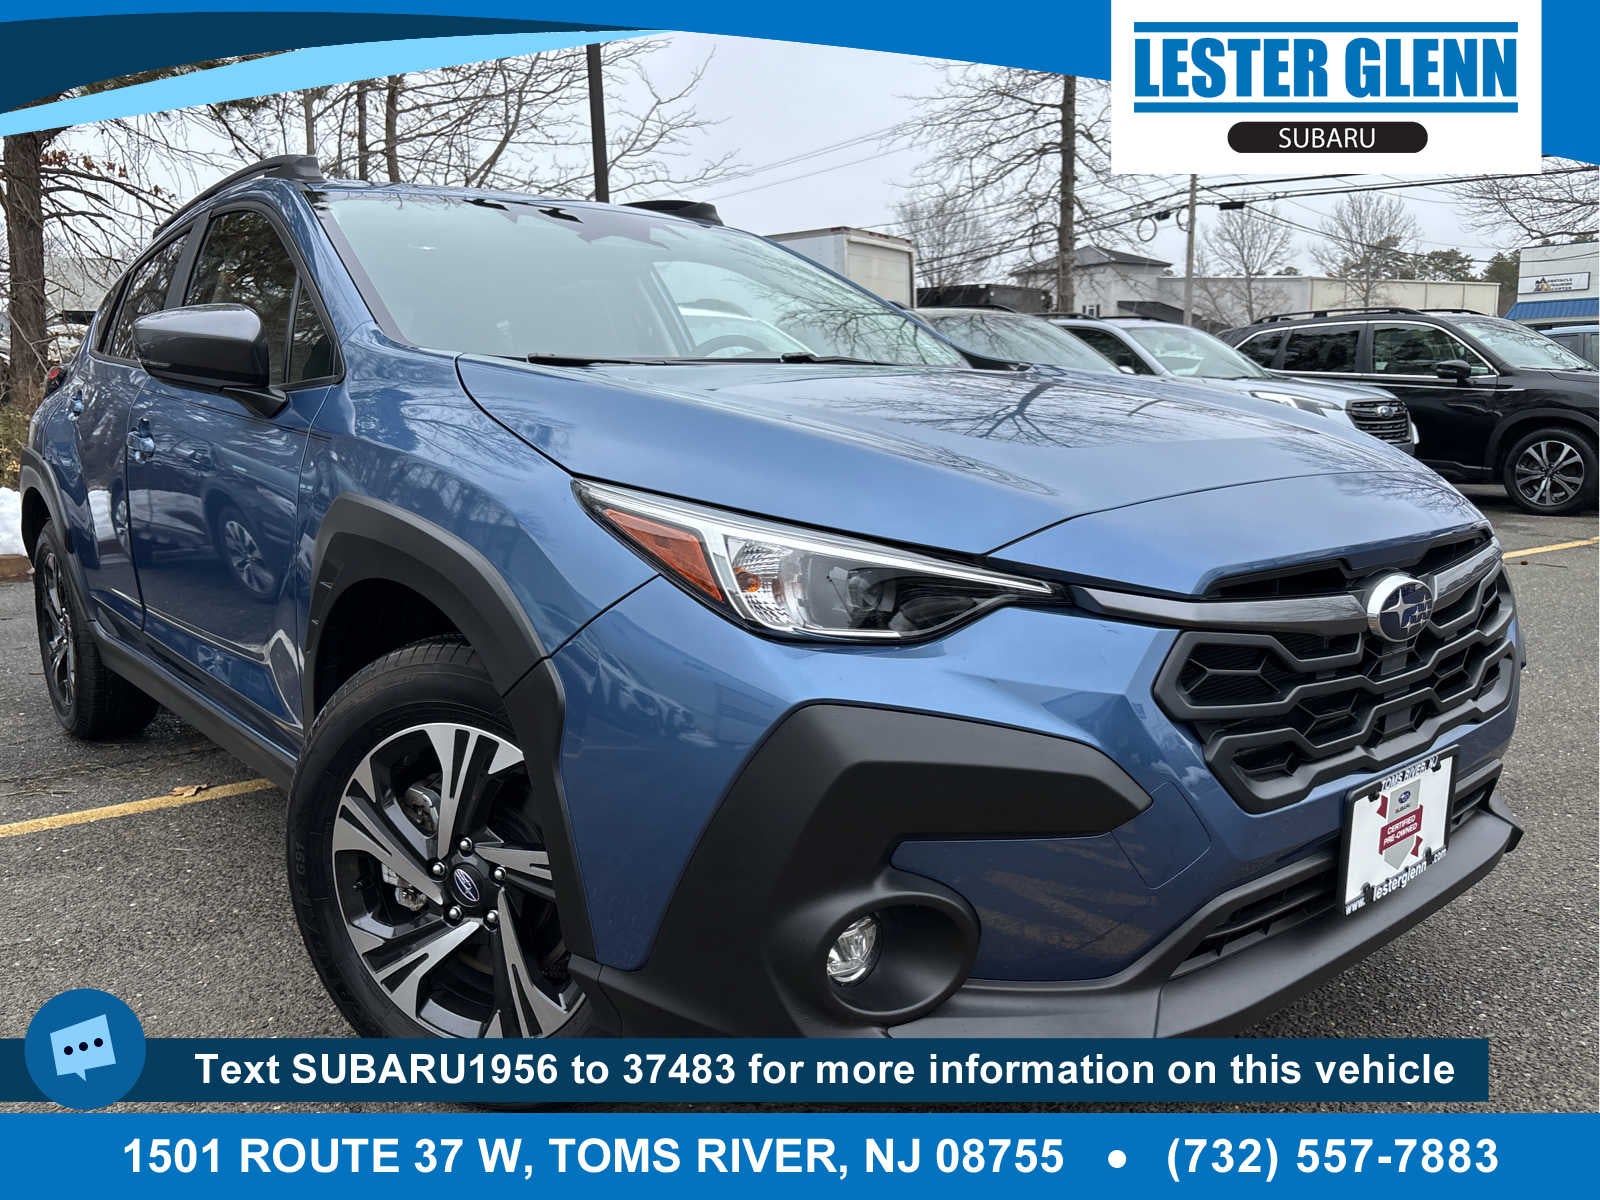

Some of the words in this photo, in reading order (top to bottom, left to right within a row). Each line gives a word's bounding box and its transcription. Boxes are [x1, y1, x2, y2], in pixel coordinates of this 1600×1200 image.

[1382, 773, 1403, 790] TOMS
[1384, 822, 1418, 845] PRE-OWNED
[1387, 815, 1416, 834] CERTIFIED
